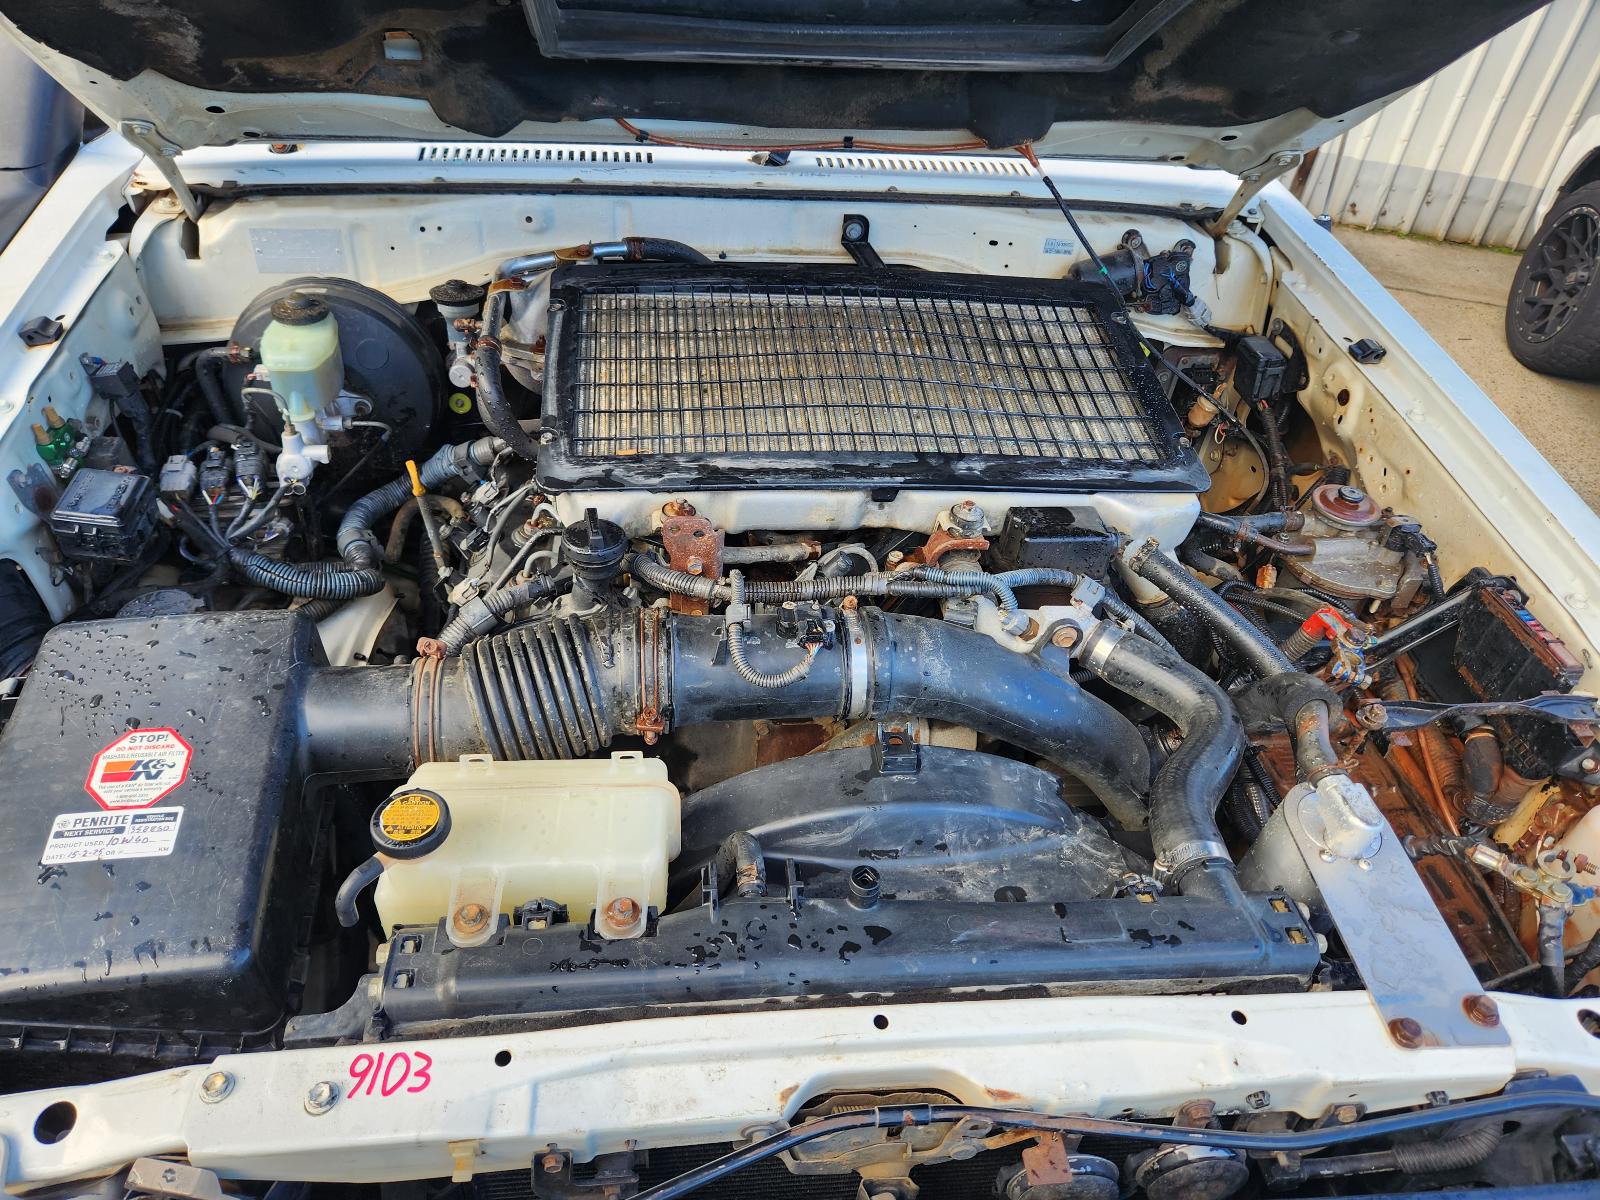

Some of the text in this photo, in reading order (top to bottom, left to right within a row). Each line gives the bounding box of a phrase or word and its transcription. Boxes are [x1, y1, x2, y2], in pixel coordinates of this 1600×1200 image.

[129, 734, 169, 743] STOP!
[72, 814, 130, 828] PENRITE
[63, 827, 116, 837] NEXT SERVICE
[49, 841, 82, 849] PRODUCT
[347, 1051, 433, 1099] 9103
